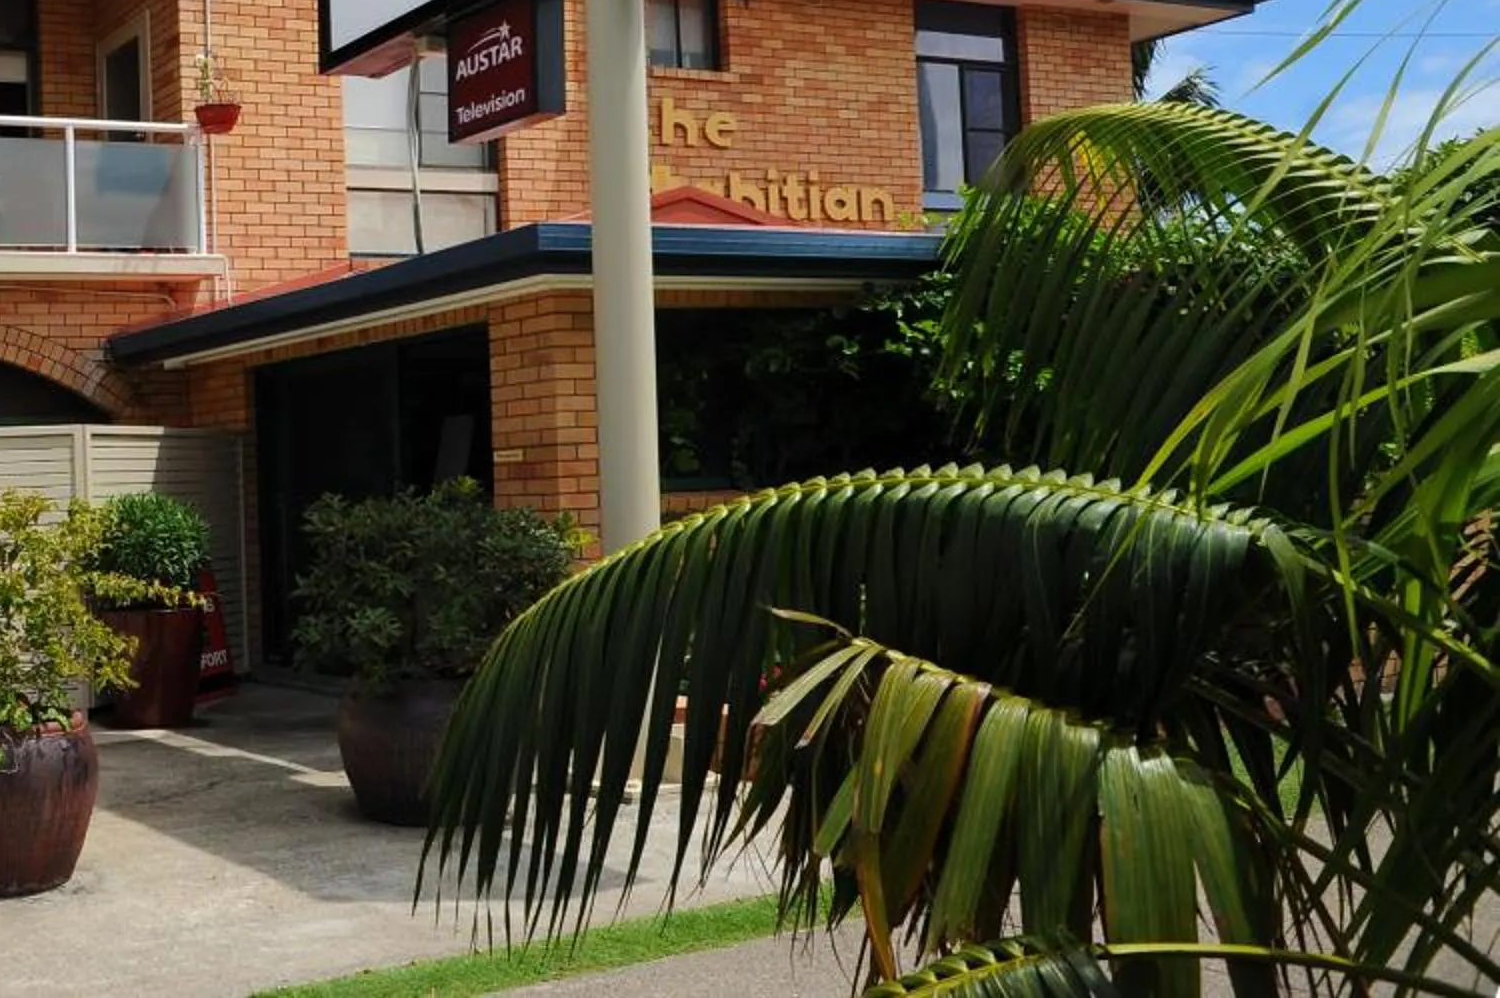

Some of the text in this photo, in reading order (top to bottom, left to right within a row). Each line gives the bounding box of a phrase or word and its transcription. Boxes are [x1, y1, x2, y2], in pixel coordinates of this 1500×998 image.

[455, 35, 523, 82] AUSTAR
[455, 87, 525, 125] Television
[652, 91, 737, 149] he
